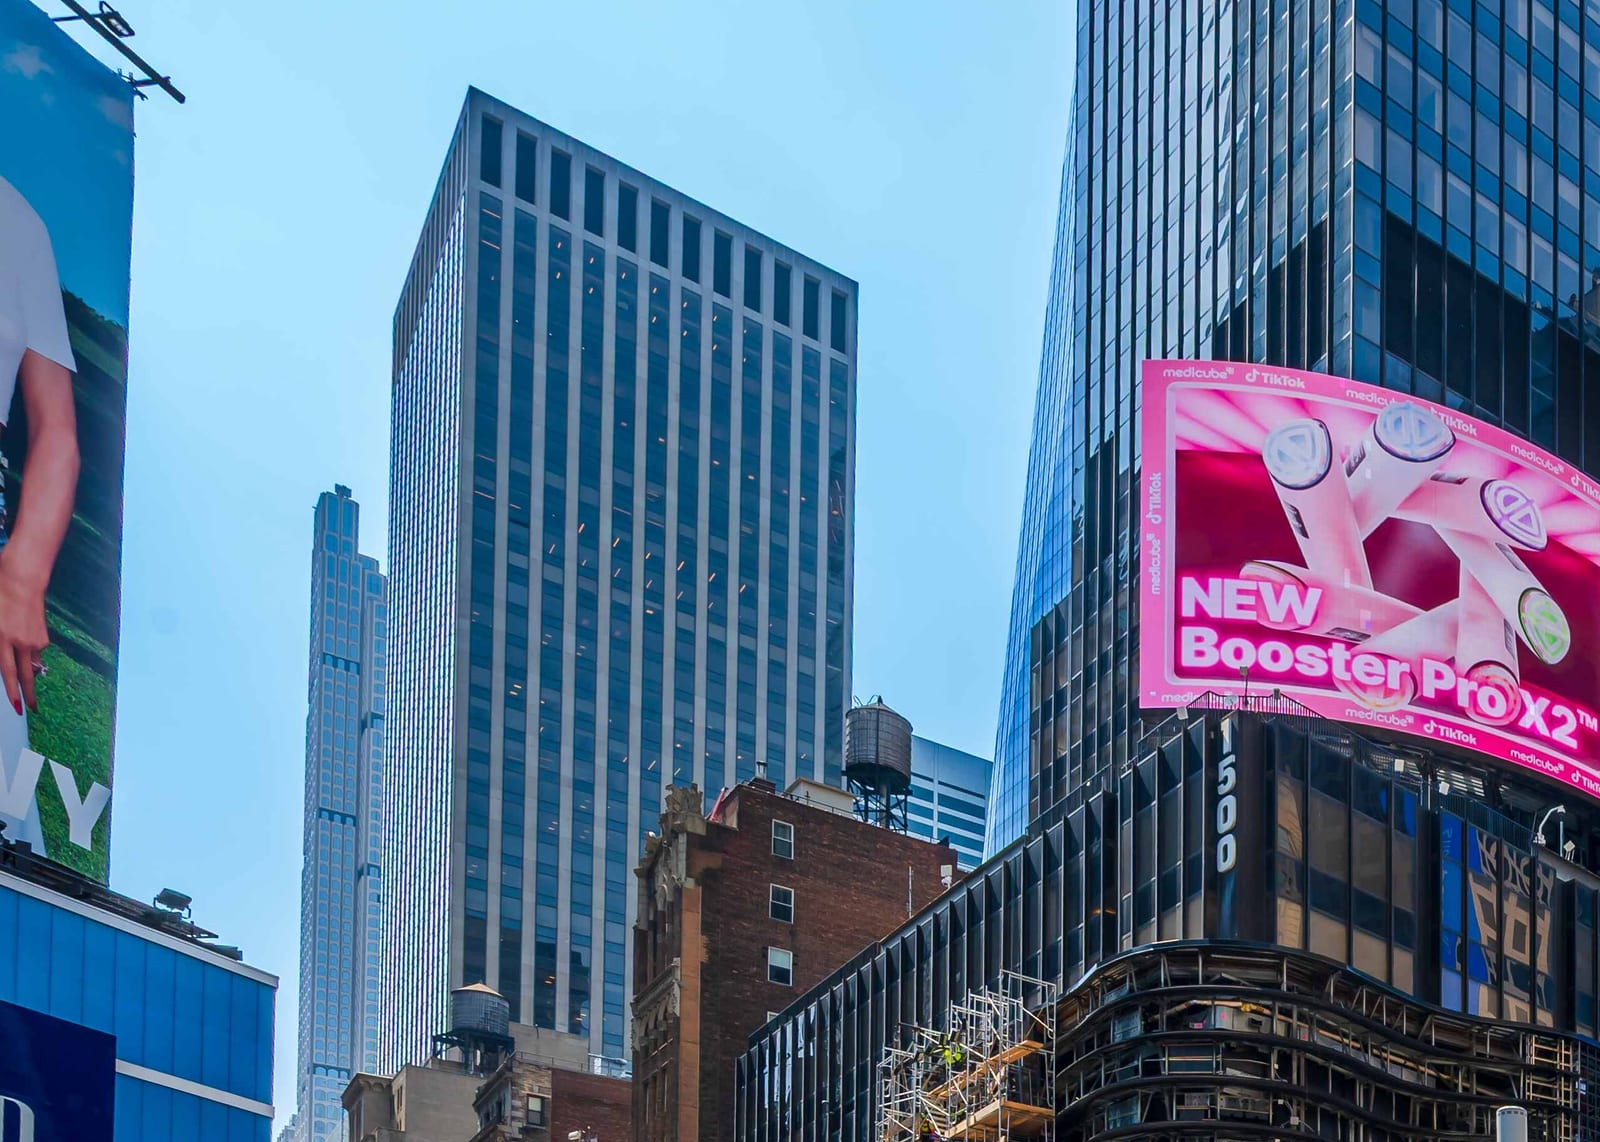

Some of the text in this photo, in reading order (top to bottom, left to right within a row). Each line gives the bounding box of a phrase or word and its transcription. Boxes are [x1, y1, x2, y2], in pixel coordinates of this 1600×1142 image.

[1163, 366, 1306, 390] medicube TikTok
[1440, 412, 1478, 437] TikTok
[1511, 443, 1560, 474] medicube
[1150, 472, 1162, 510] TikTok
[1181, 576, 1323, 627] NEW
[1180, 627, 1412, 692] Booster
[1422, 659, 1508, 720] Pro
[1345, 707, 1478, 747] medicube TikTok
[1510, 749, 1558, 774] medicube
[1217, 718, 1237, 873] 1500
